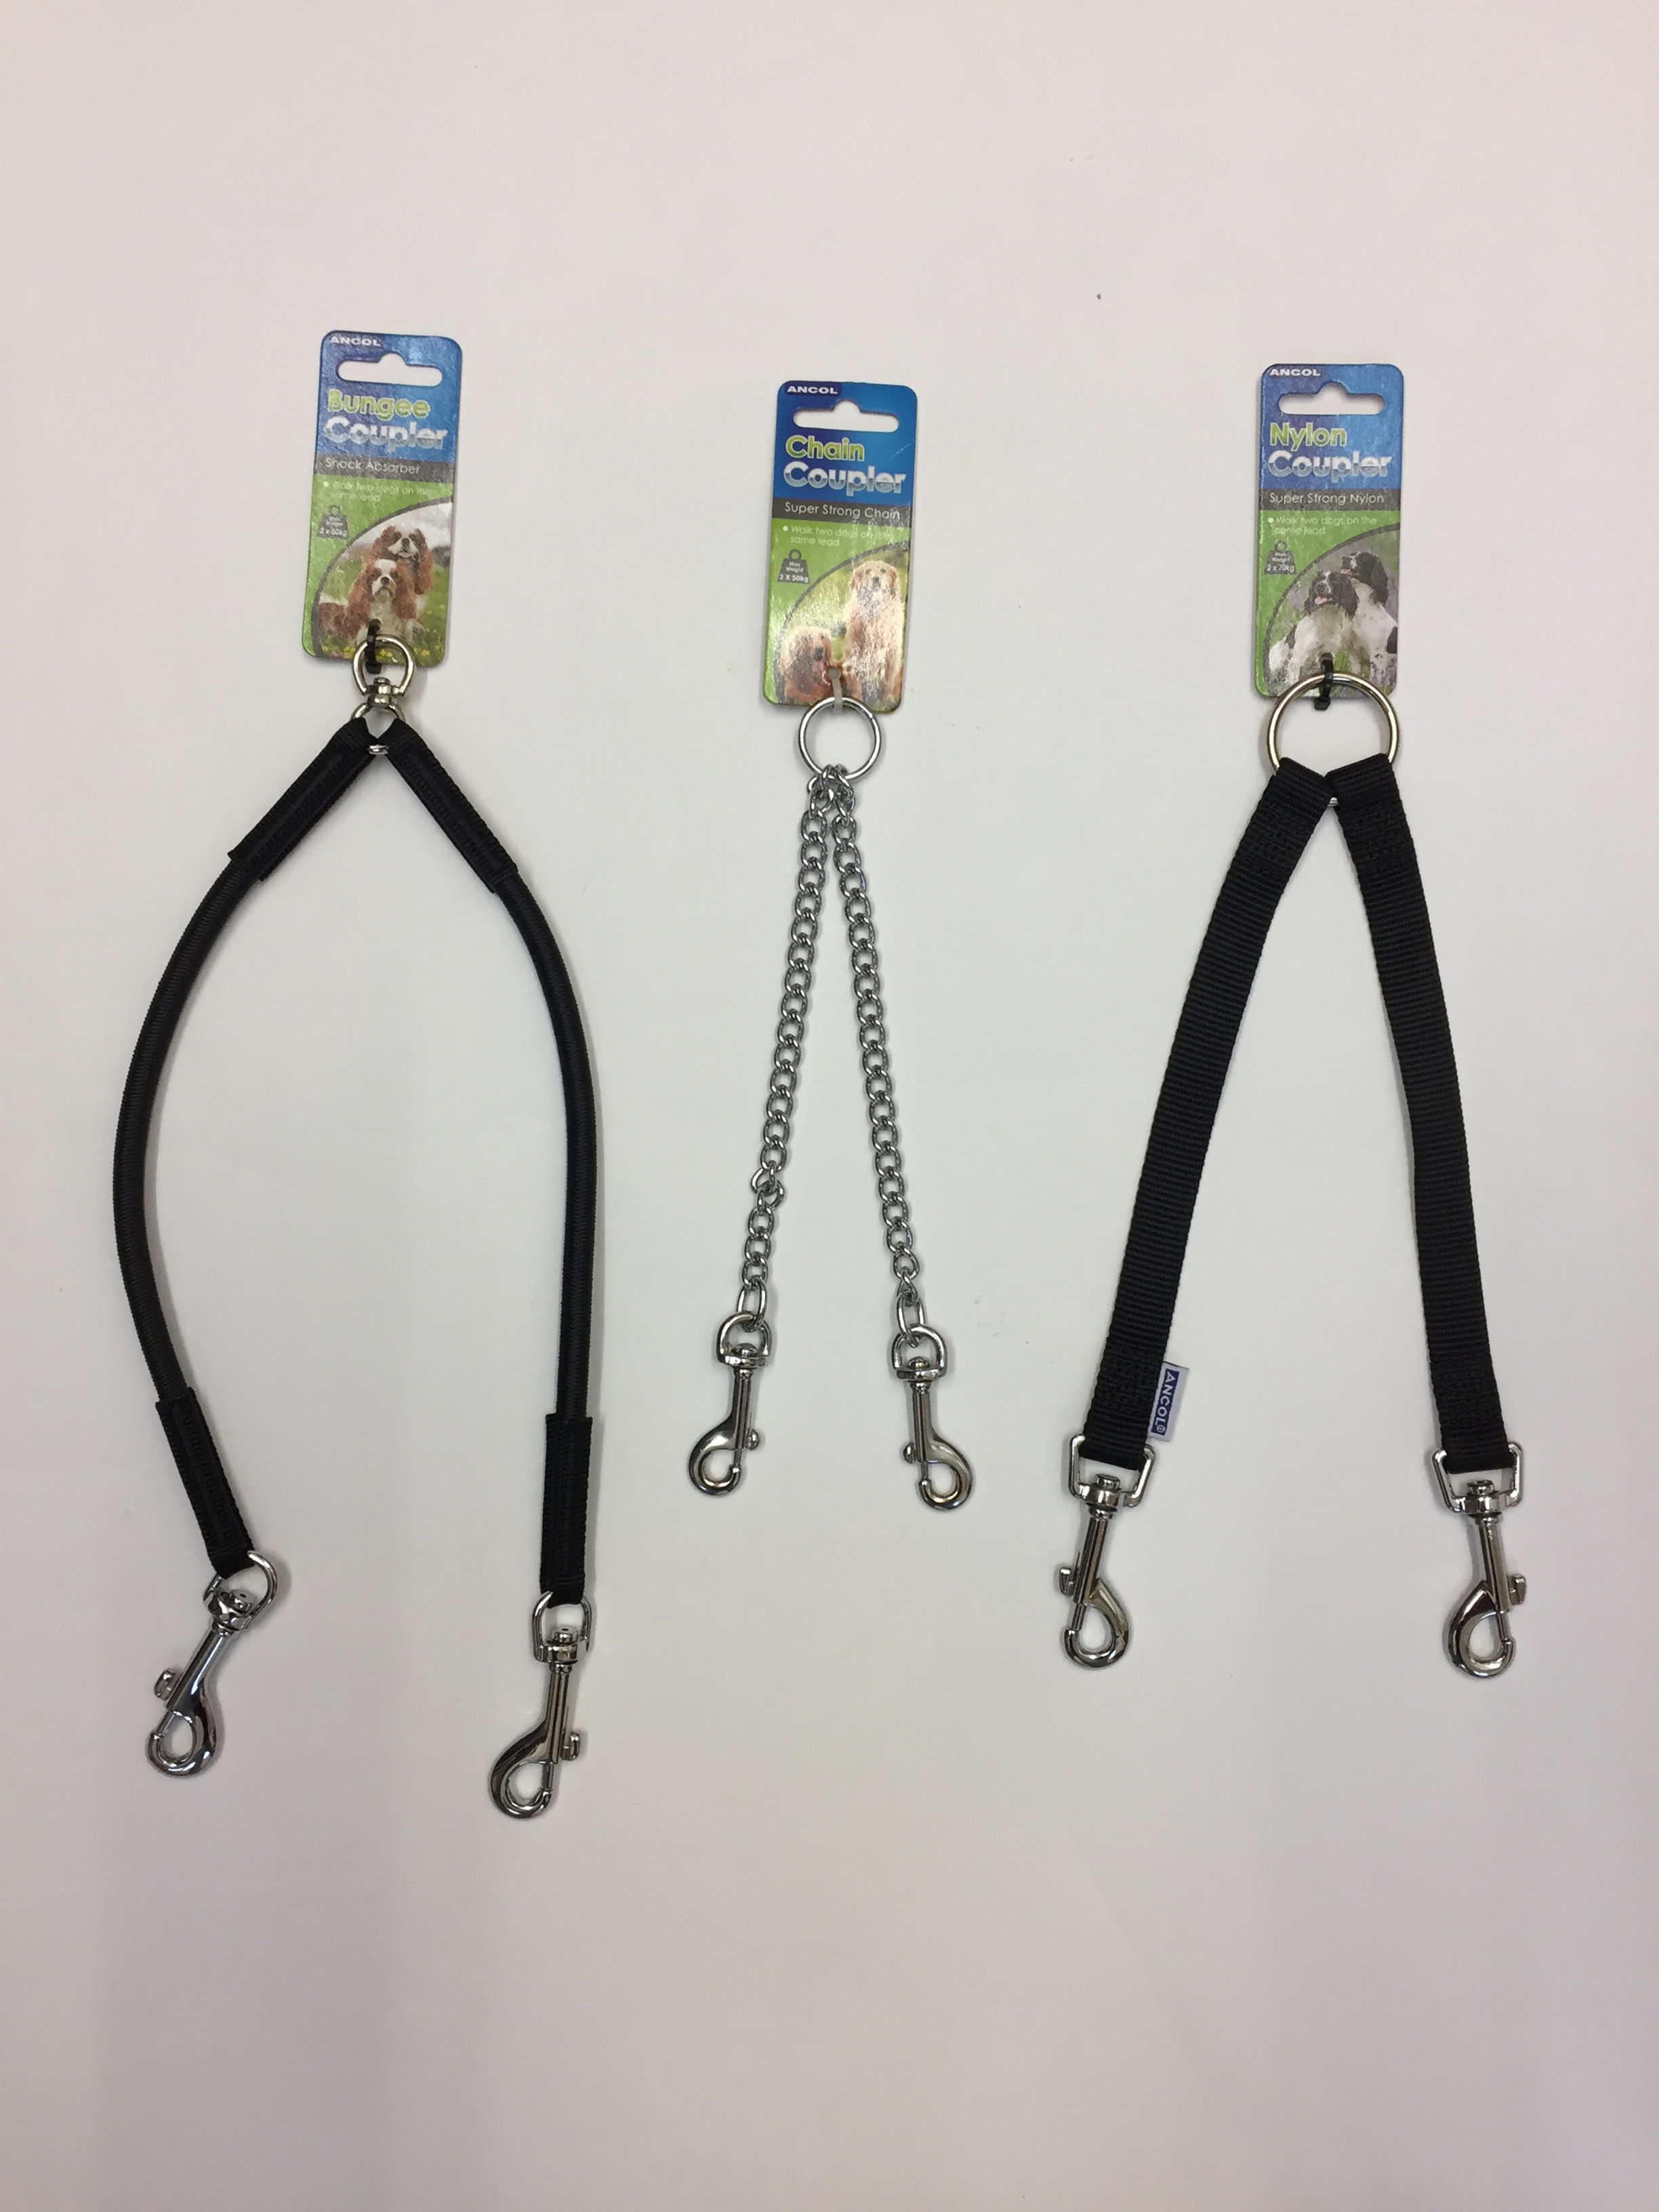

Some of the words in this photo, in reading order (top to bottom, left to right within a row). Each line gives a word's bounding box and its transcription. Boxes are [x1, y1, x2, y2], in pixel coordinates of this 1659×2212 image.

[329, 335, 382, 346] ANCOL
[1268, 368, 1322, 377] ANCOL
[787, 386, 838, 394] ANCOL
[327, 388, 430, 421] Bungee
[324, 415, 449, 453] Coupler
[1269, 422, 1347, 452] Nylon
[785, 434, 865, 462] Chain
[325, 457, 362, 470] Shock
[365, 461, 421, 474] Absorber
[1267, 450, 1392, 483] Coupler
[783, 461, 907, 497] Coupler
[1269, 493, 1304, 504] Super
[1307, 493, 1346, 506] Strong
[1350, 493, 1385, 506] Nylon
[785, 501, 820, 515] Super
[823, 504, 861, 519] Strong
[864, 507, 901, 520] Chain
[1361, 516, 1377, 525] the
[790, 525, 813, 535] Walk
[815, 527, 833, 536] two
[835, 527, 858, 539] dogs
[792, 574, 808, 583] 50kg
